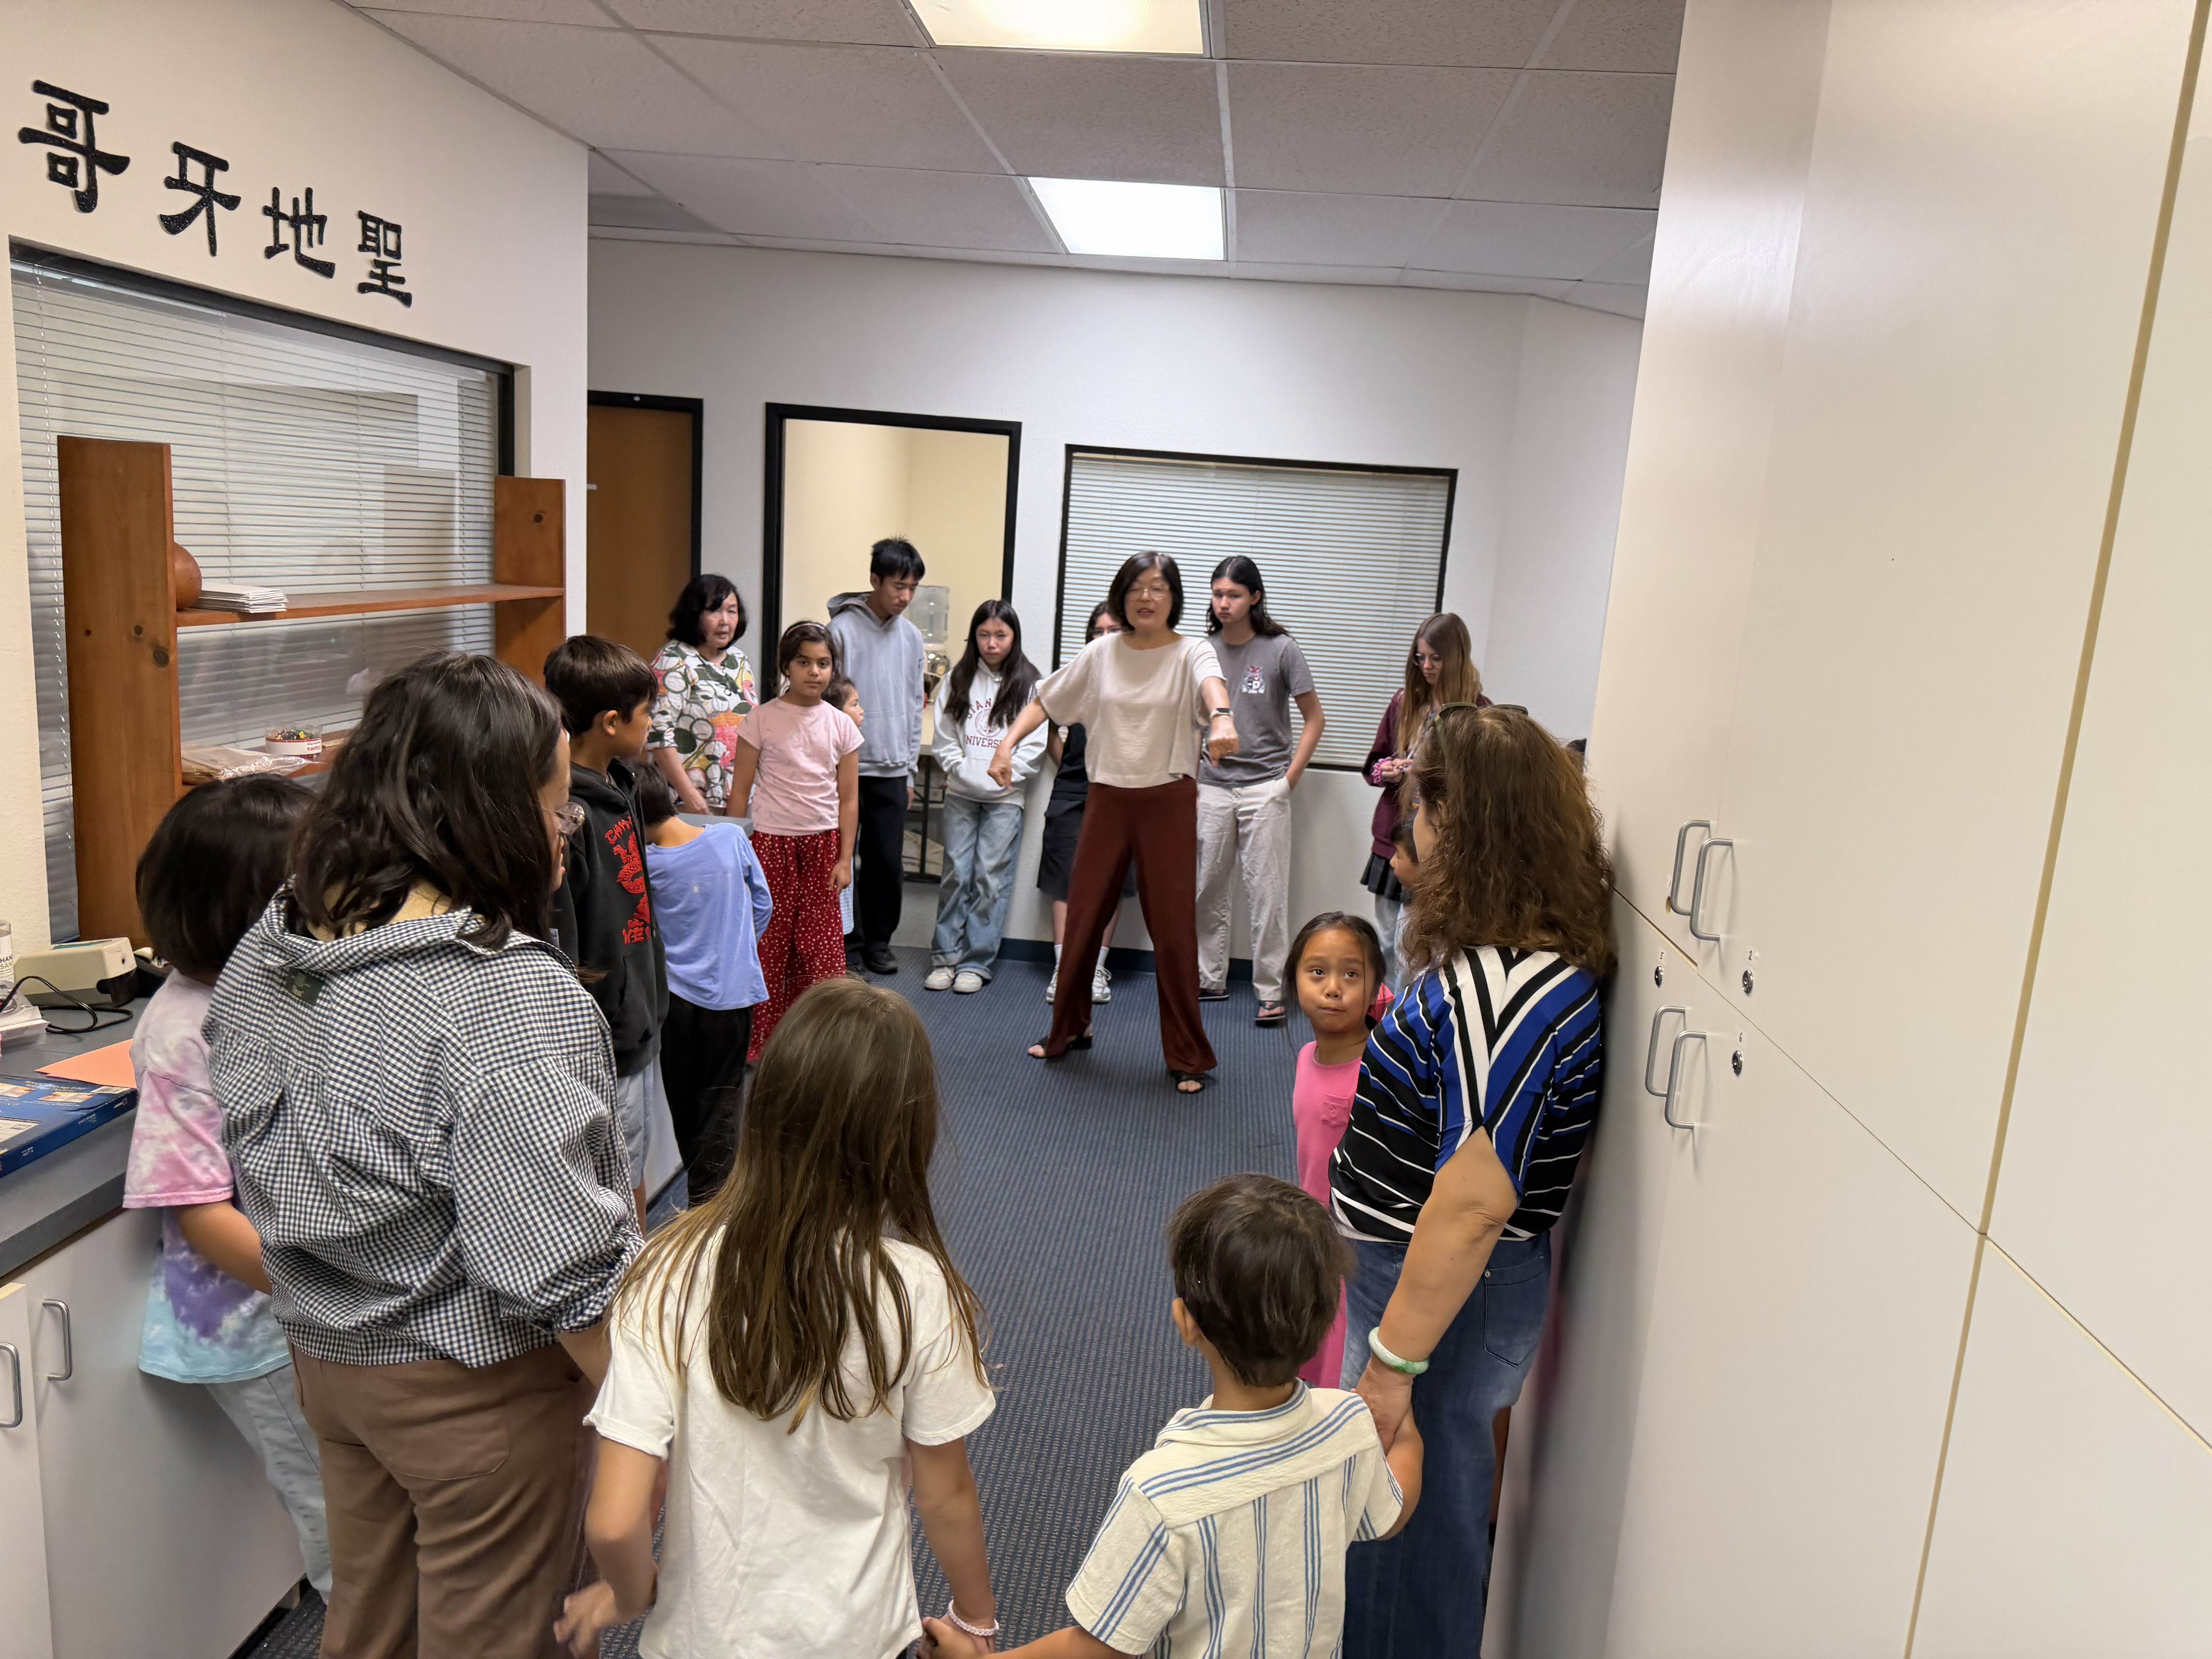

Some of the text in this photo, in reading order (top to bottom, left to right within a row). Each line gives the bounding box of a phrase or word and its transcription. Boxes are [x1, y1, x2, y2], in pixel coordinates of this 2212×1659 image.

[966, 735, 1001, 749] NIVERS
[0, 954, 13, 963] HAN
[1748, 950, 1752, 960] 2
[1739, 1032, 1743, 1042] 6
